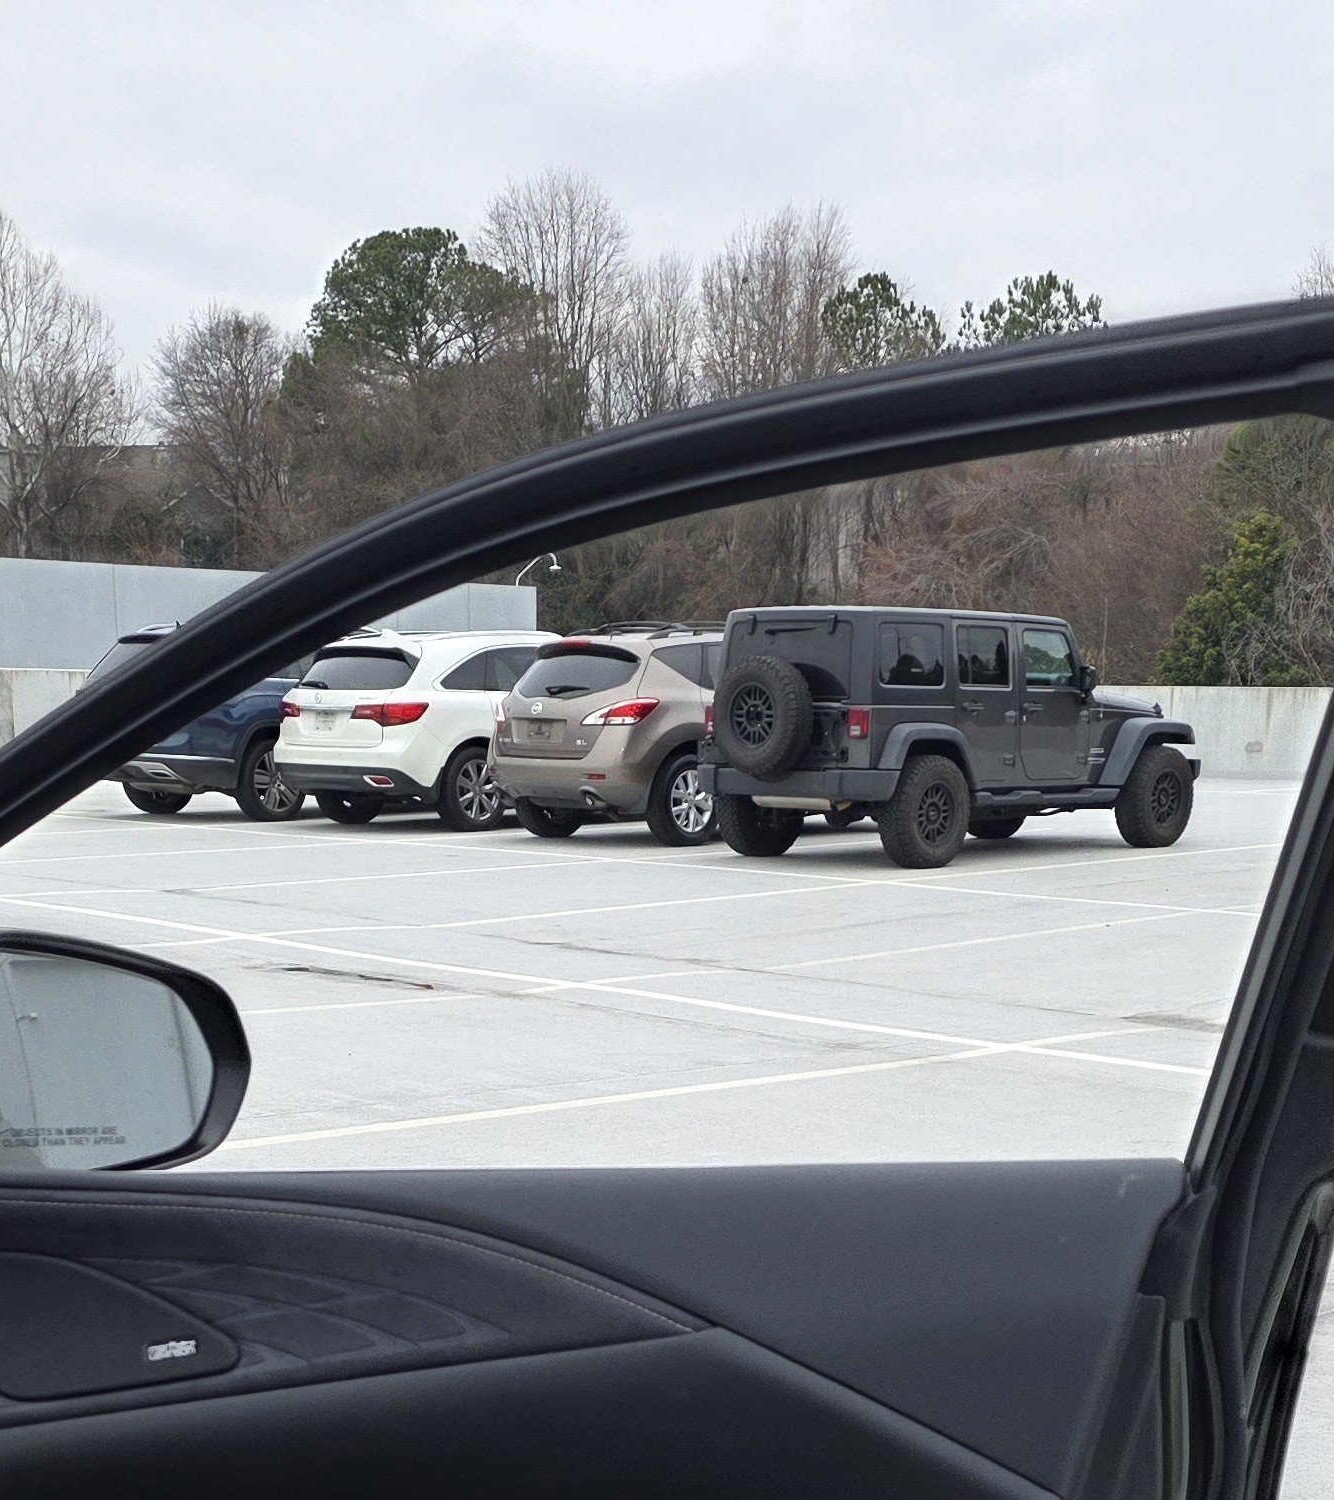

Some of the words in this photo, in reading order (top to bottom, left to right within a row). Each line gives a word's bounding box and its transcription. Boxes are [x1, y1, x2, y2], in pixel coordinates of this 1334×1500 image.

[66, 1127, 98, 1137] MIRROR
[3, 1138, 38, 1148] CLOSER
[42, 1137, 65, 1146] THAN
[69, 1136, 90, 1146] THEY
[93, 1136, 126, 1145] APPEAR
